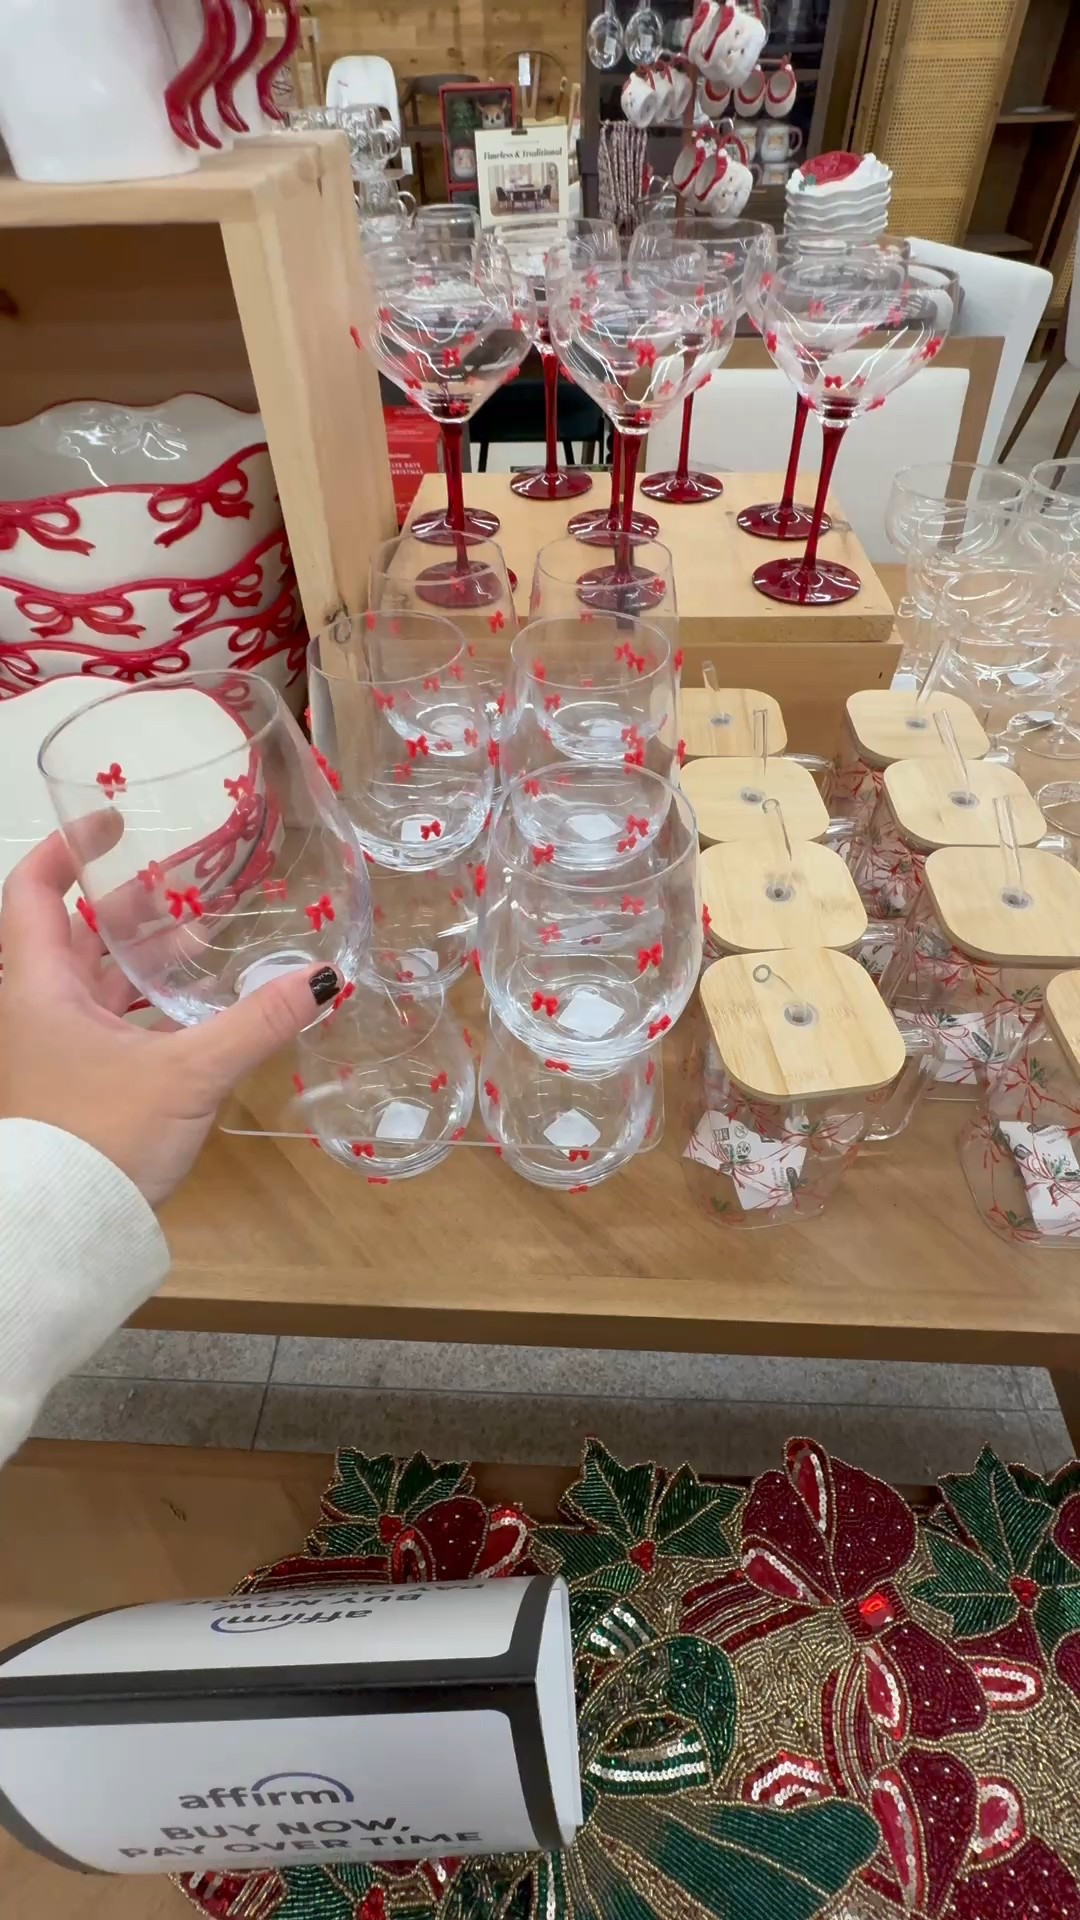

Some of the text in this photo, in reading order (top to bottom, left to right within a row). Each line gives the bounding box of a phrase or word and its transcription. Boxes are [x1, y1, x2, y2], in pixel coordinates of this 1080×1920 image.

[483, 147, 563, 161] Timeless & Traditional
[330, 1593, 422, 1605] BUY
[226, 1609, 373, 1625] affirm
[178, 1786, 341, 1810] affirm
[160, 1817, 411, 1841] BUY NOW,
[119, 1832, 484, 1859] PAY OVER TIME
